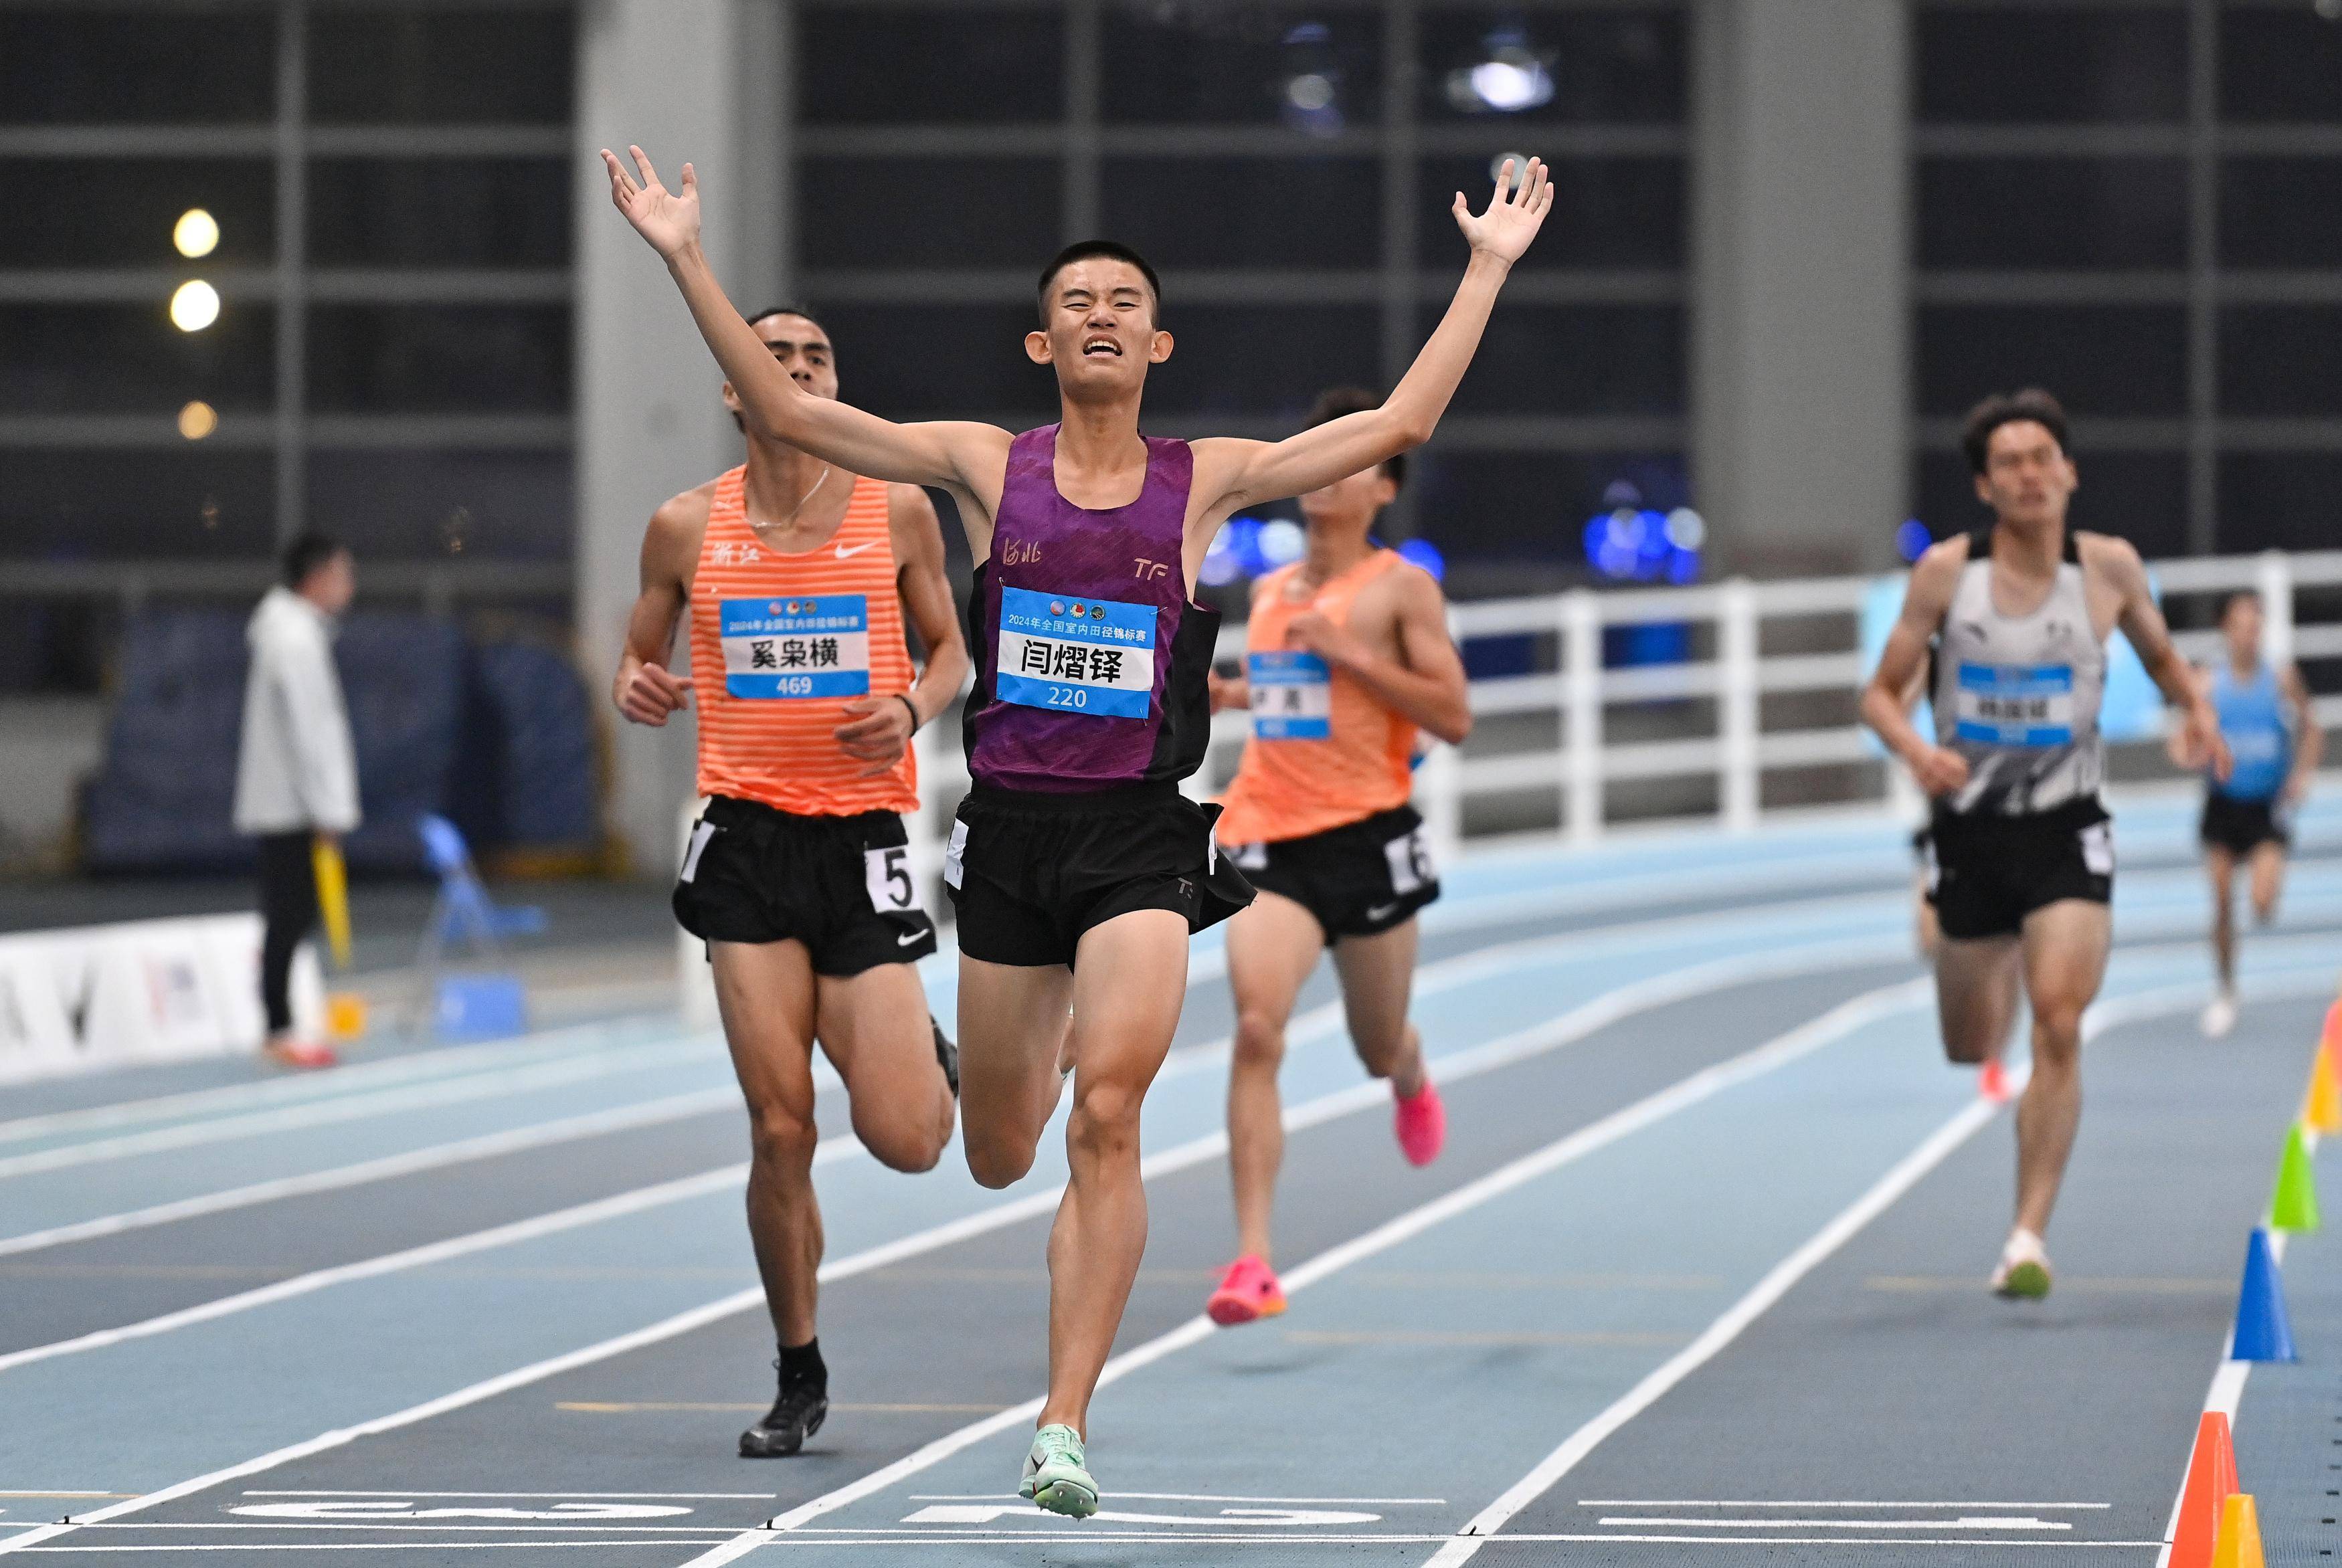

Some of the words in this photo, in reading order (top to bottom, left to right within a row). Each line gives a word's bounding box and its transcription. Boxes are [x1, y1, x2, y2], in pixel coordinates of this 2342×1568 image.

[1134, 557, 1168, 581] TF
[1008, 614, 1146, 642] 2024年全国室内田径锦标赛
[751, 638, 839, 669] 奚枭横
[1021, 639, 1123, 683] 闫熠铎
[776, 676, 812, 695] 469
[1047, 686, 1087, 707] 220
[884, 849, 913, 907] 5
